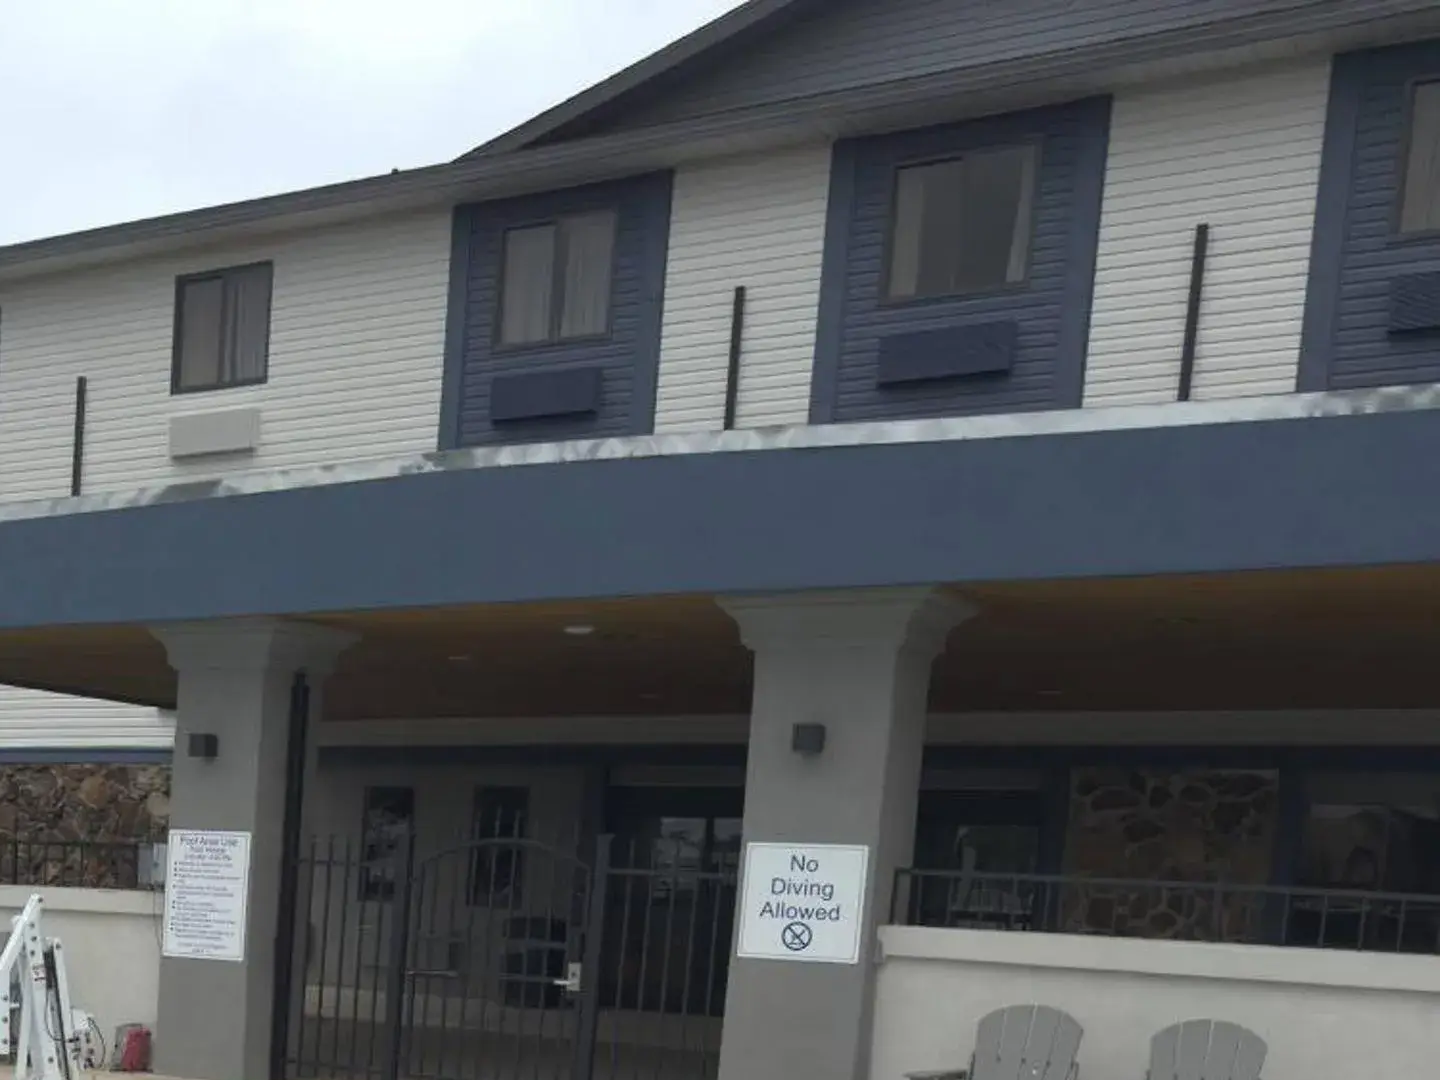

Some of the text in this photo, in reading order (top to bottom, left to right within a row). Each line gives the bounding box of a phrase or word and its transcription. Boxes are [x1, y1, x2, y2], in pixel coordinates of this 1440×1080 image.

[790, 855, 819, 873] No
[771, 877, 834, 901] Diving
[759, 901, 841, 921] Allowed
